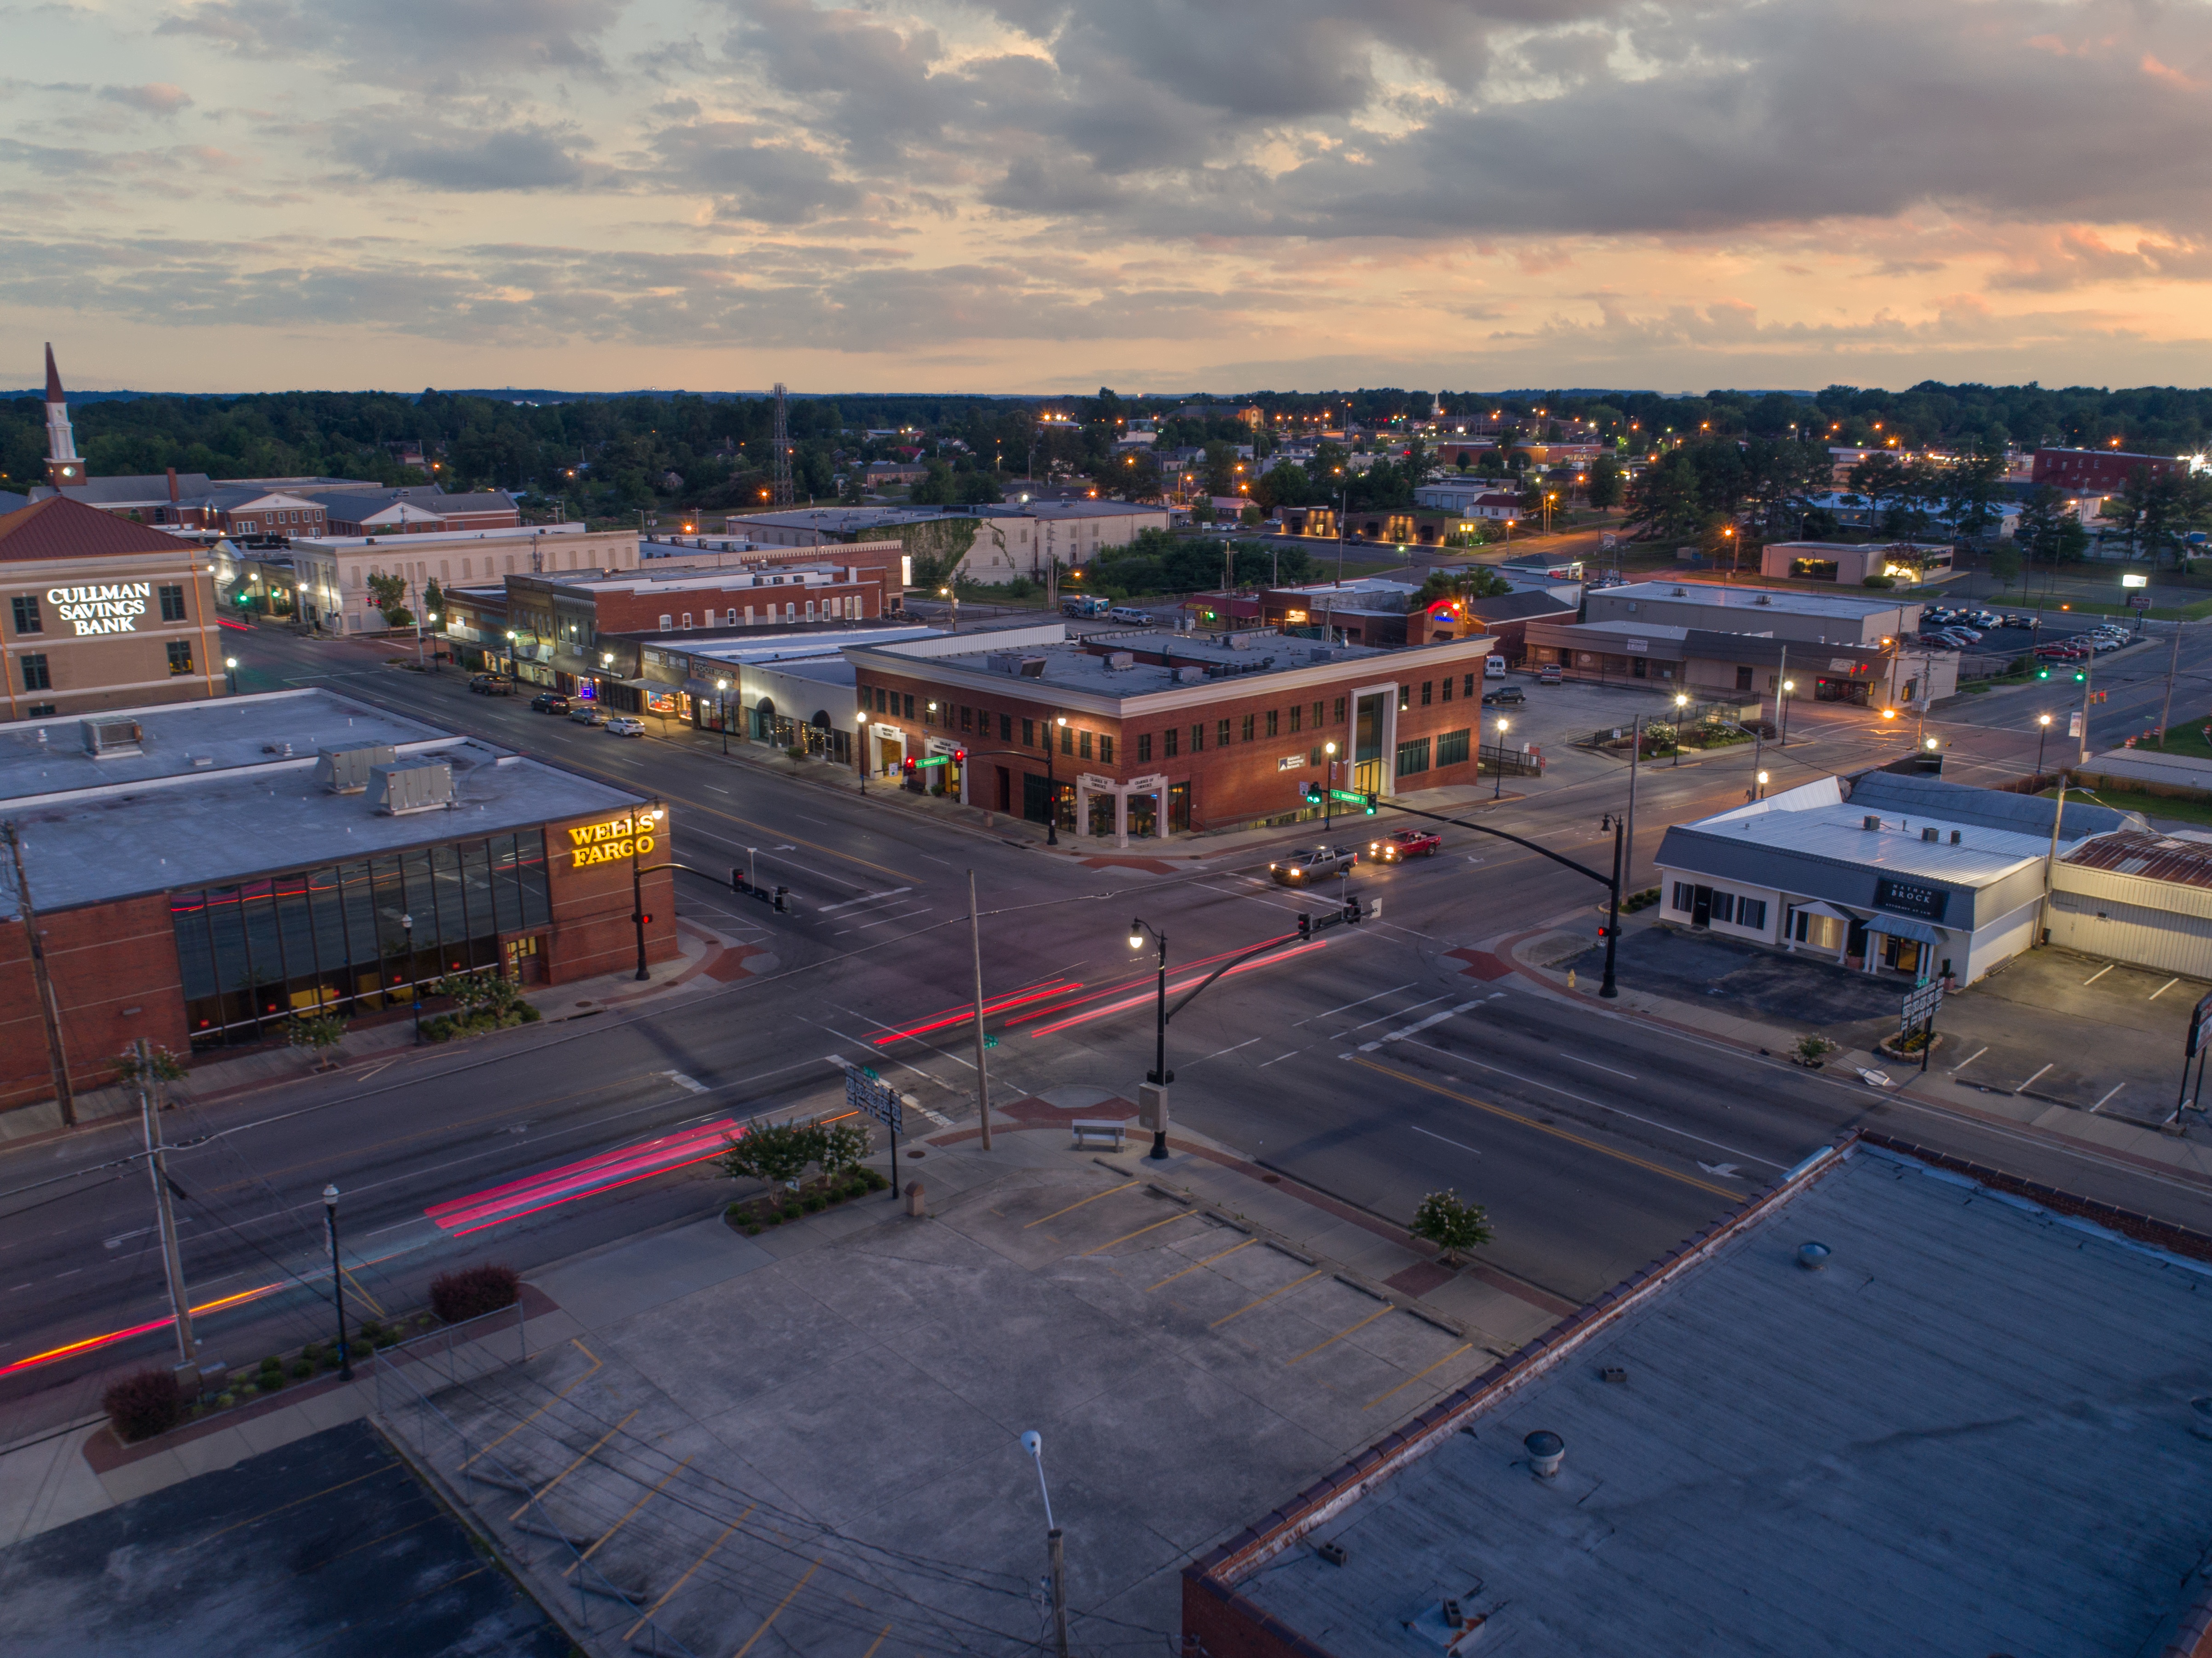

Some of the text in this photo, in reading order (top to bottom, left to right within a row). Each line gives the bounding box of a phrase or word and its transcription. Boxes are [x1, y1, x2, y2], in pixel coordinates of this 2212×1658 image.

[47, 582, 150, 604] CULLMAN
[59, 599, 145, 620] SAVINGS
[73, 616, 136, 636] BANK
[694, 663, 733, 678] FOOTWORK
[568, 814, 655, 845] WELLS
[572, 836, 654, 867] FARGO
[1891, 889, 1930, 903] BROCK
[1893, 884, 1932, 895] NATHAN
